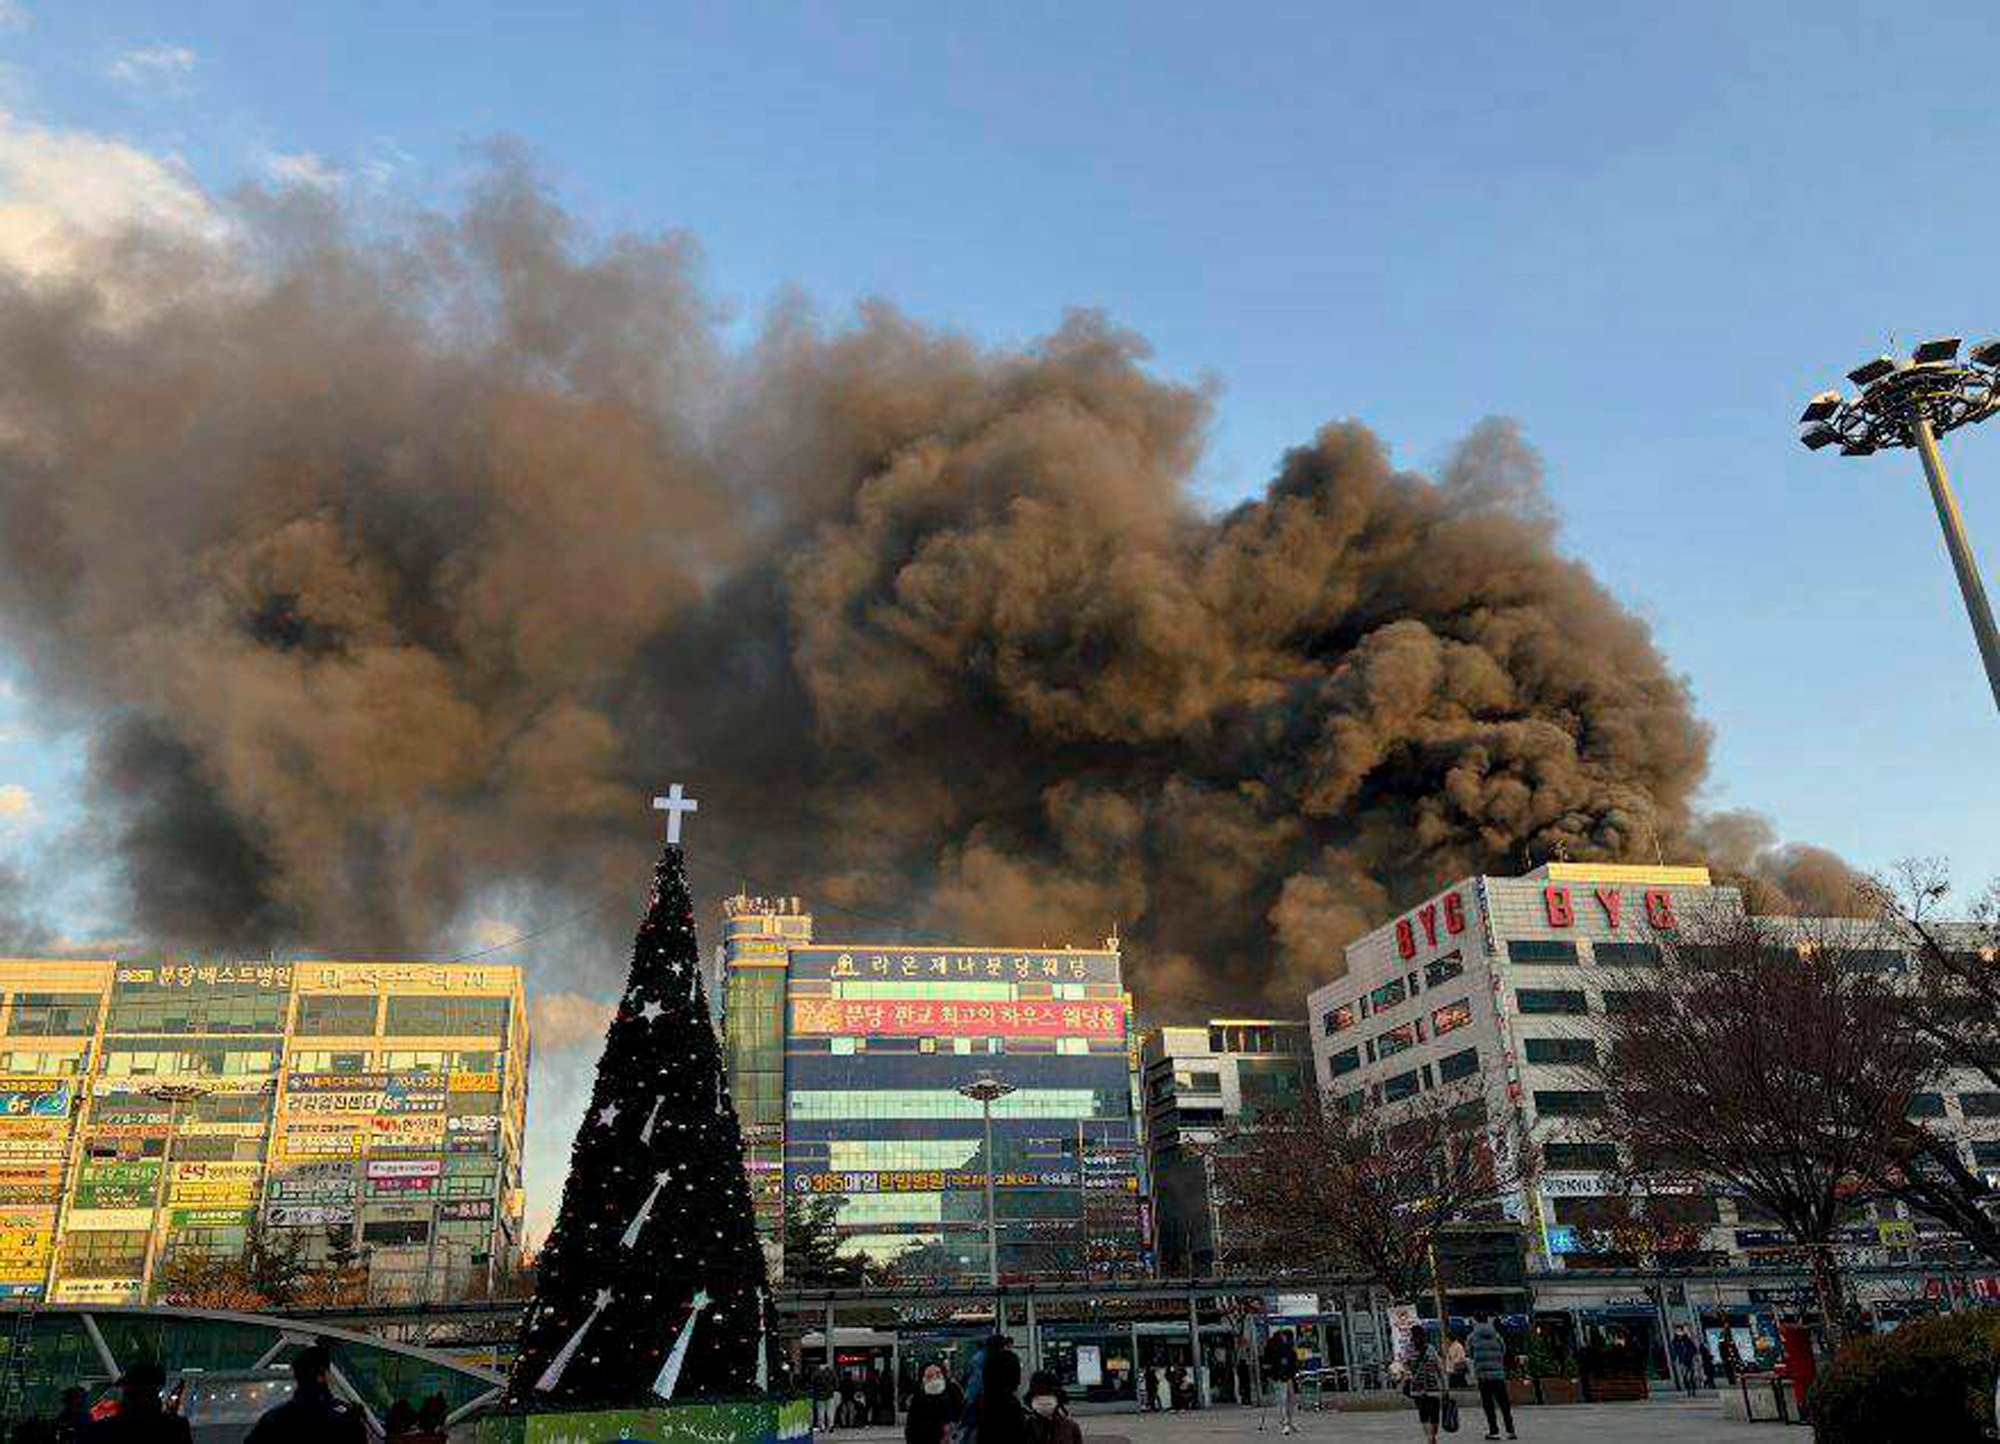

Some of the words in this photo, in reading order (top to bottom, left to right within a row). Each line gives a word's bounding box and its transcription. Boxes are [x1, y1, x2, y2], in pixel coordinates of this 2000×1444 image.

[1396, 891, 1465, 961] BYC
[1544, 885, 1677, 930] BYC
[845, 1004, 884, 1029] 분당
[895, 1004, 935, 1027] 판교
[942, 1005, 996, 1028] 최고의
[1000, 1005, 1057, 1028] 하우스
